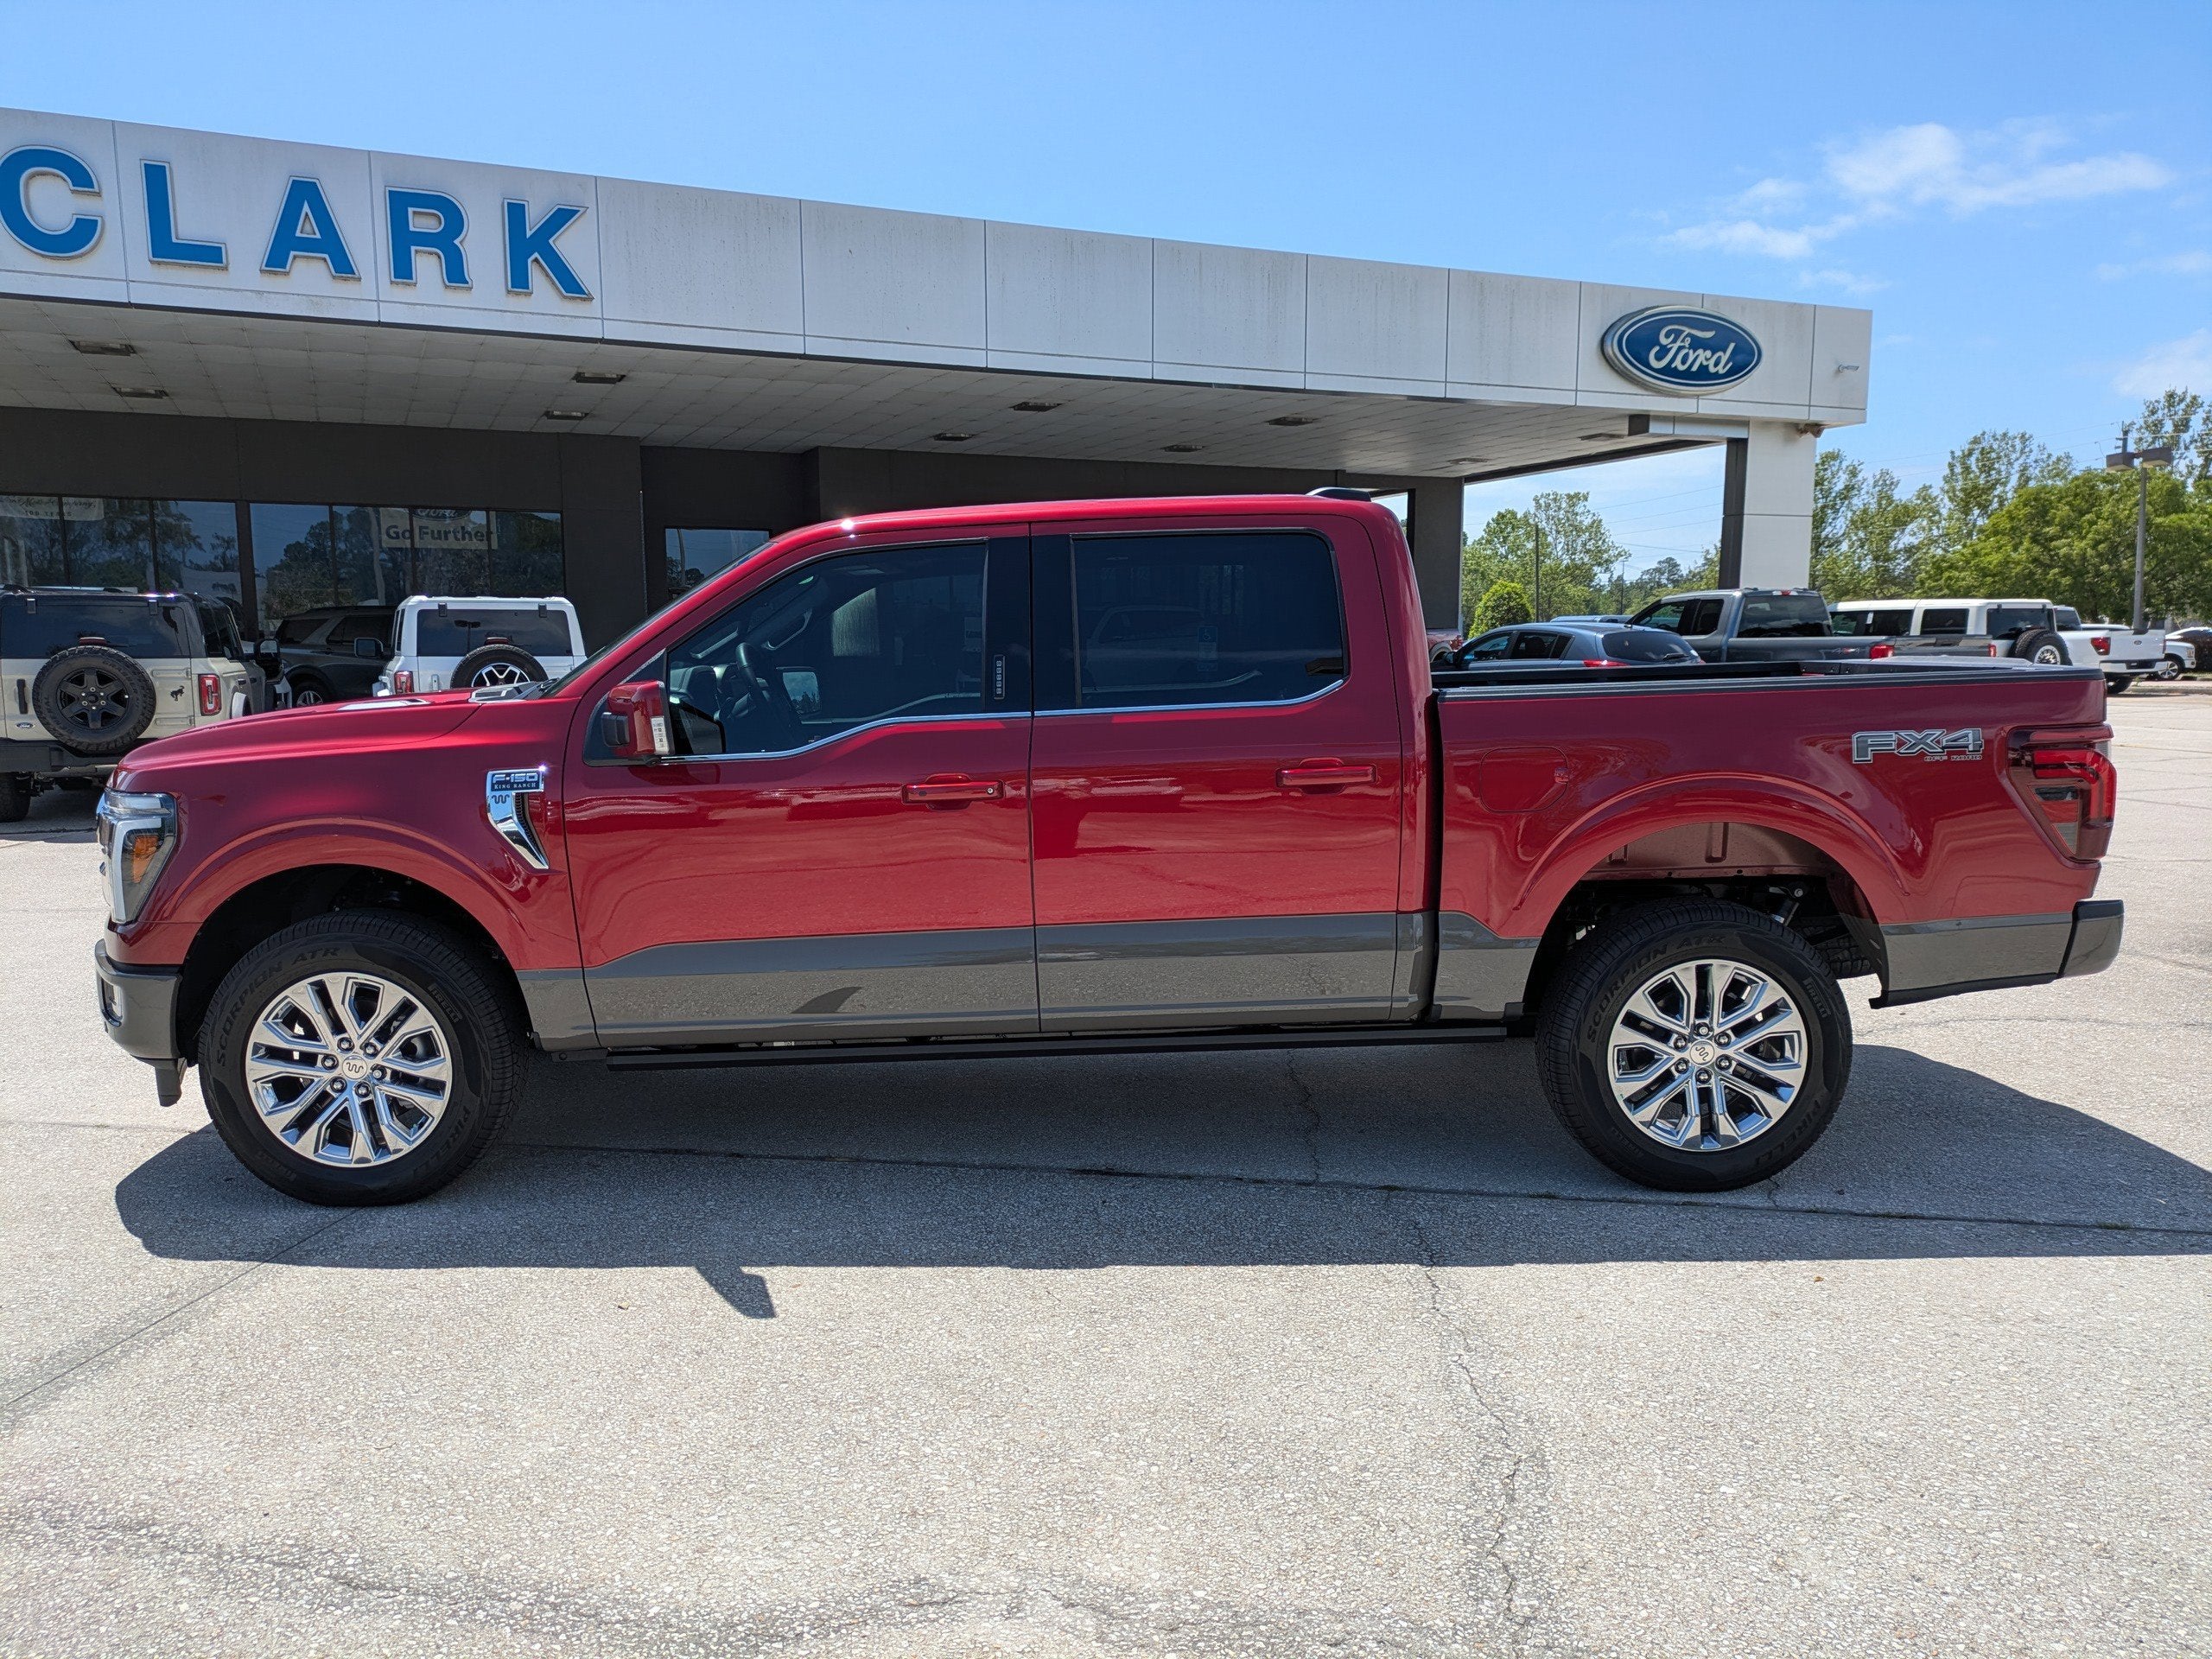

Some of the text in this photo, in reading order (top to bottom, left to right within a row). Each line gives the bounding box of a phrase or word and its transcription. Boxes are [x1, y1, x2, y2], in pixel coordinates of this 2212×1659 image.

[0, 144, 594, 301] CLARK
[1649, 325, 1736, 374] Ford
[493, 772, 537, 783] F-150
[1852, 728, 1984, 764] FX4
[217, 959, 284, 1066] SCORPION
[1586, 944, 1669, 1043] SCORPION
